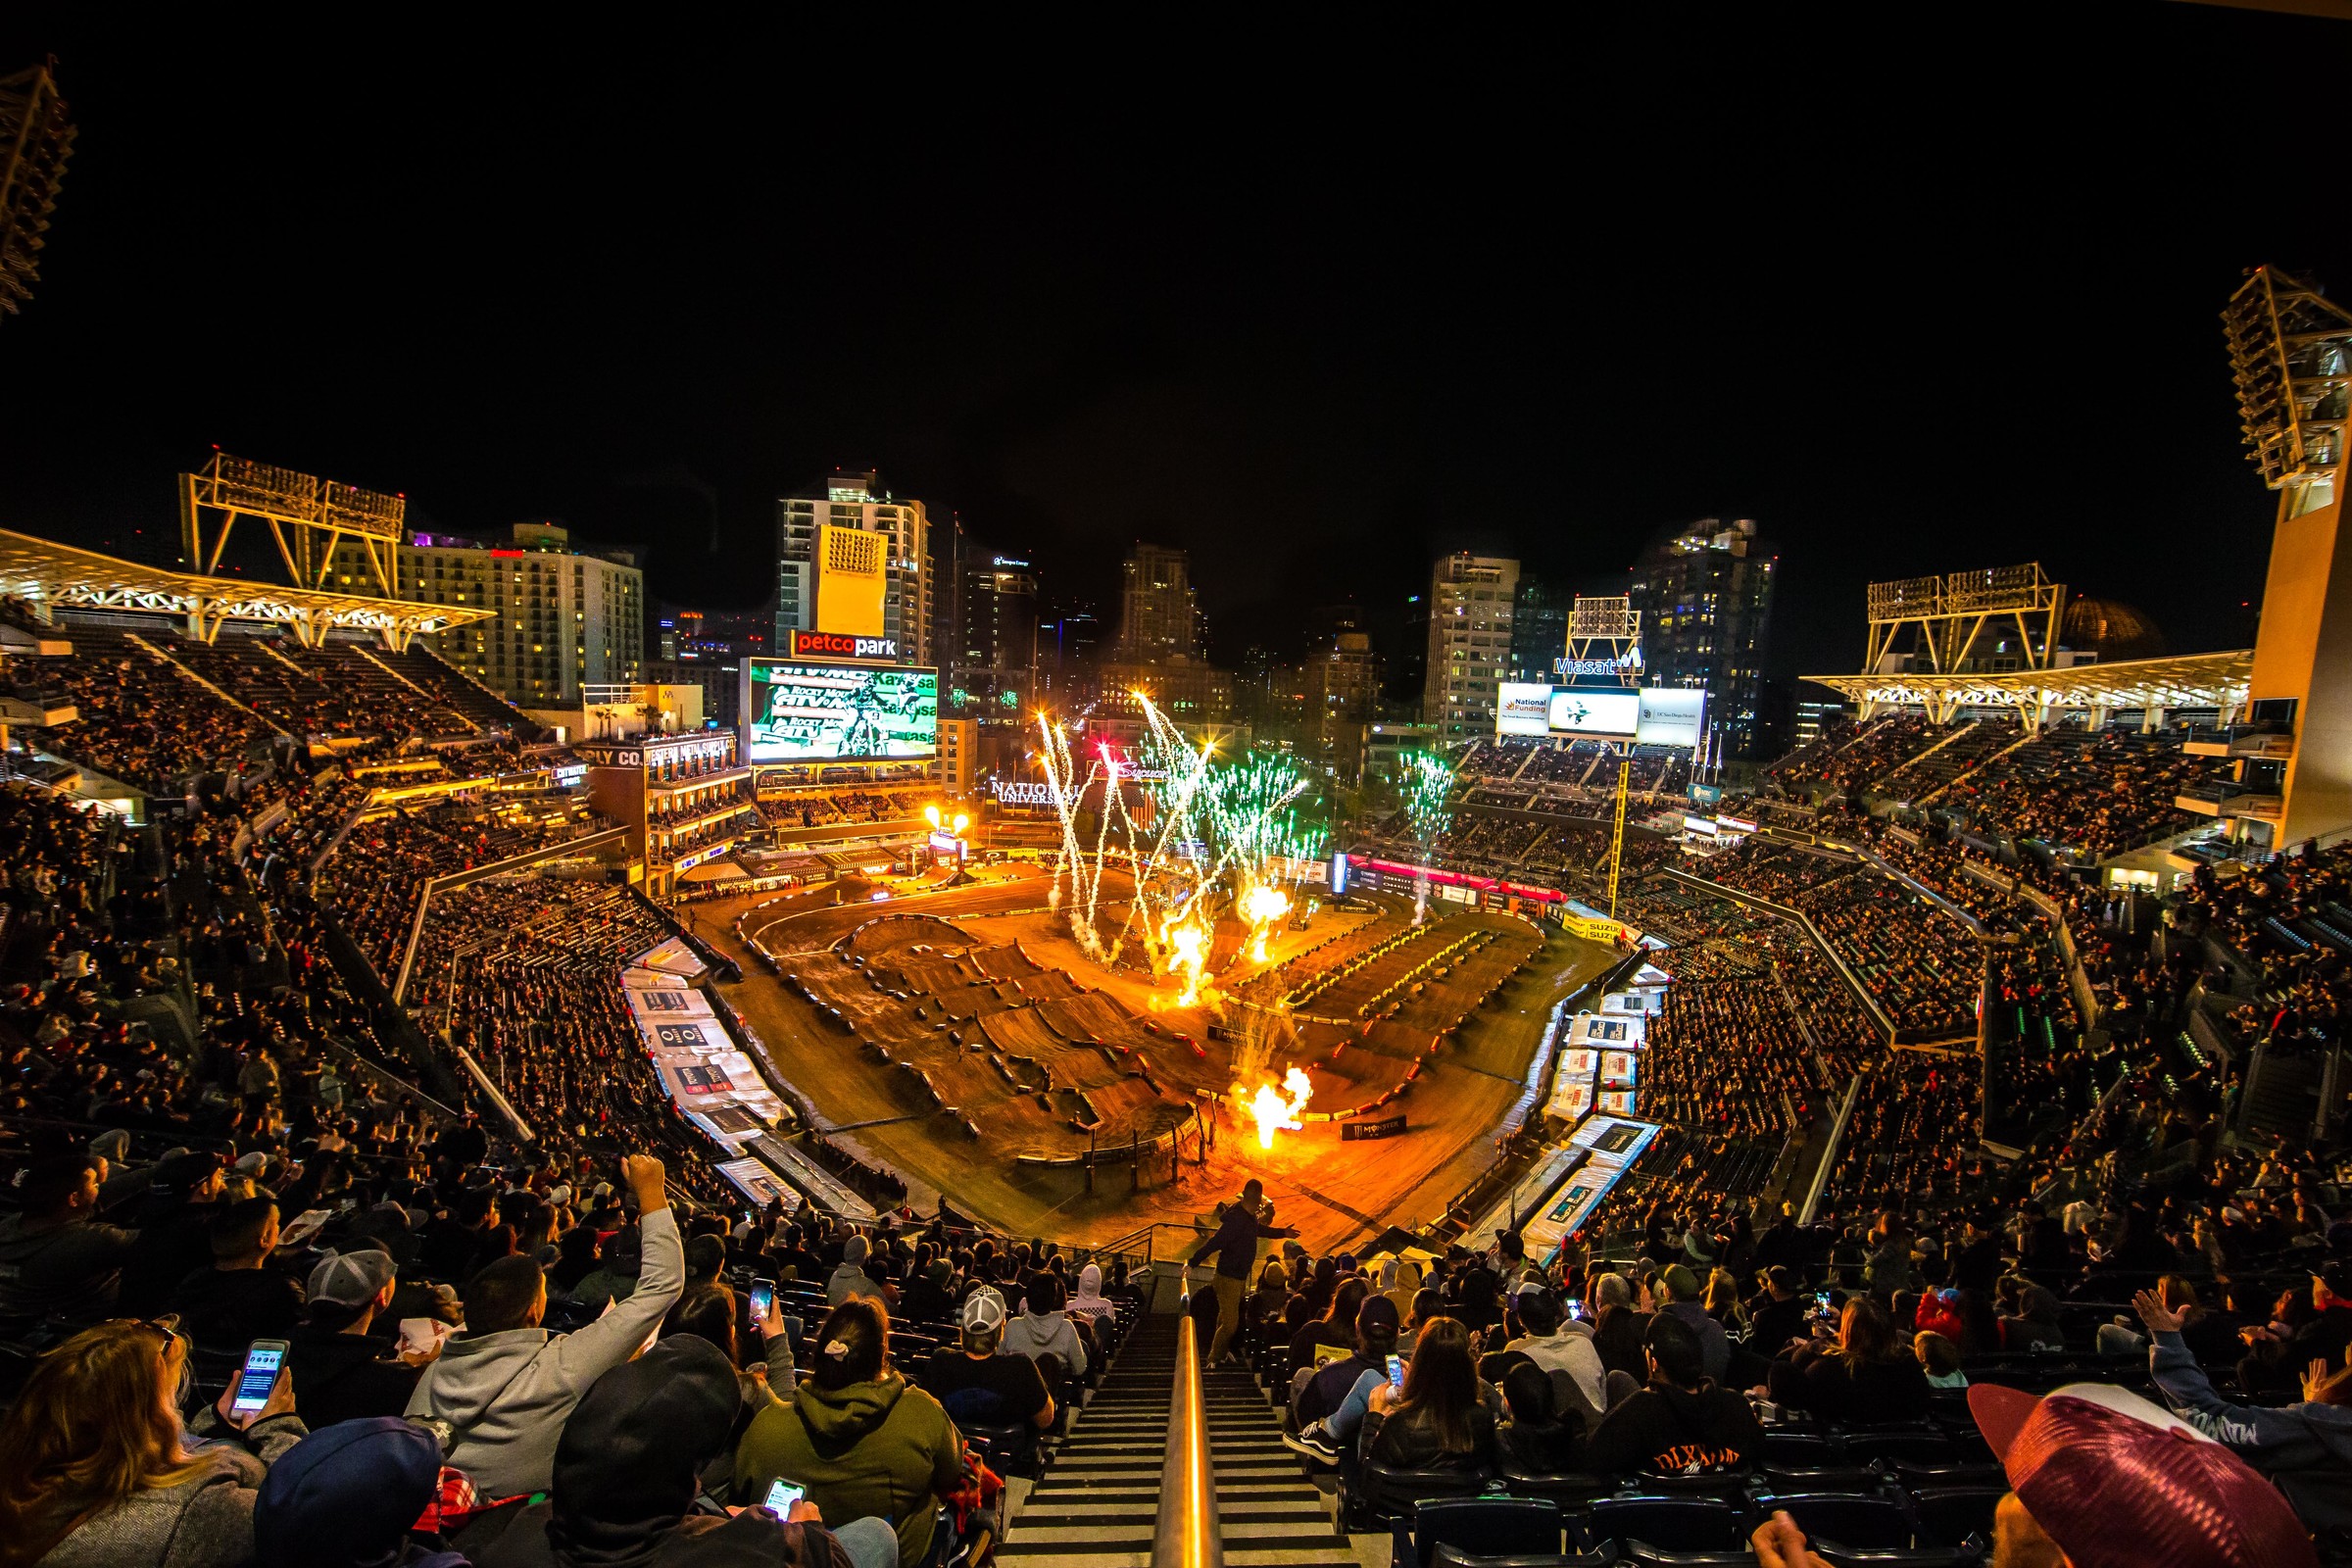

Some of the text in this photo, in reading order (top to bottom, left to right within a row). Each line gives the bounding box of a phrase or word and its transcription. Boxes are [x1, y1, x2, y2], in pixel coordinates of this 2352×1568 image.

[1556, 658, 1616, 675] Viasat
[791, 686, 823, 696] ROCKY
[789, 717, 822, 726] ROCKY
[645, 747, 678, 761] WESTERN
[703, 739, 724, 752] SUPPLY
[618, 751, 643, 766] CO.
[1590, 924, 1621, 934] SUZUKI
[1364, 1121, 1399, 1133] MONSTER
